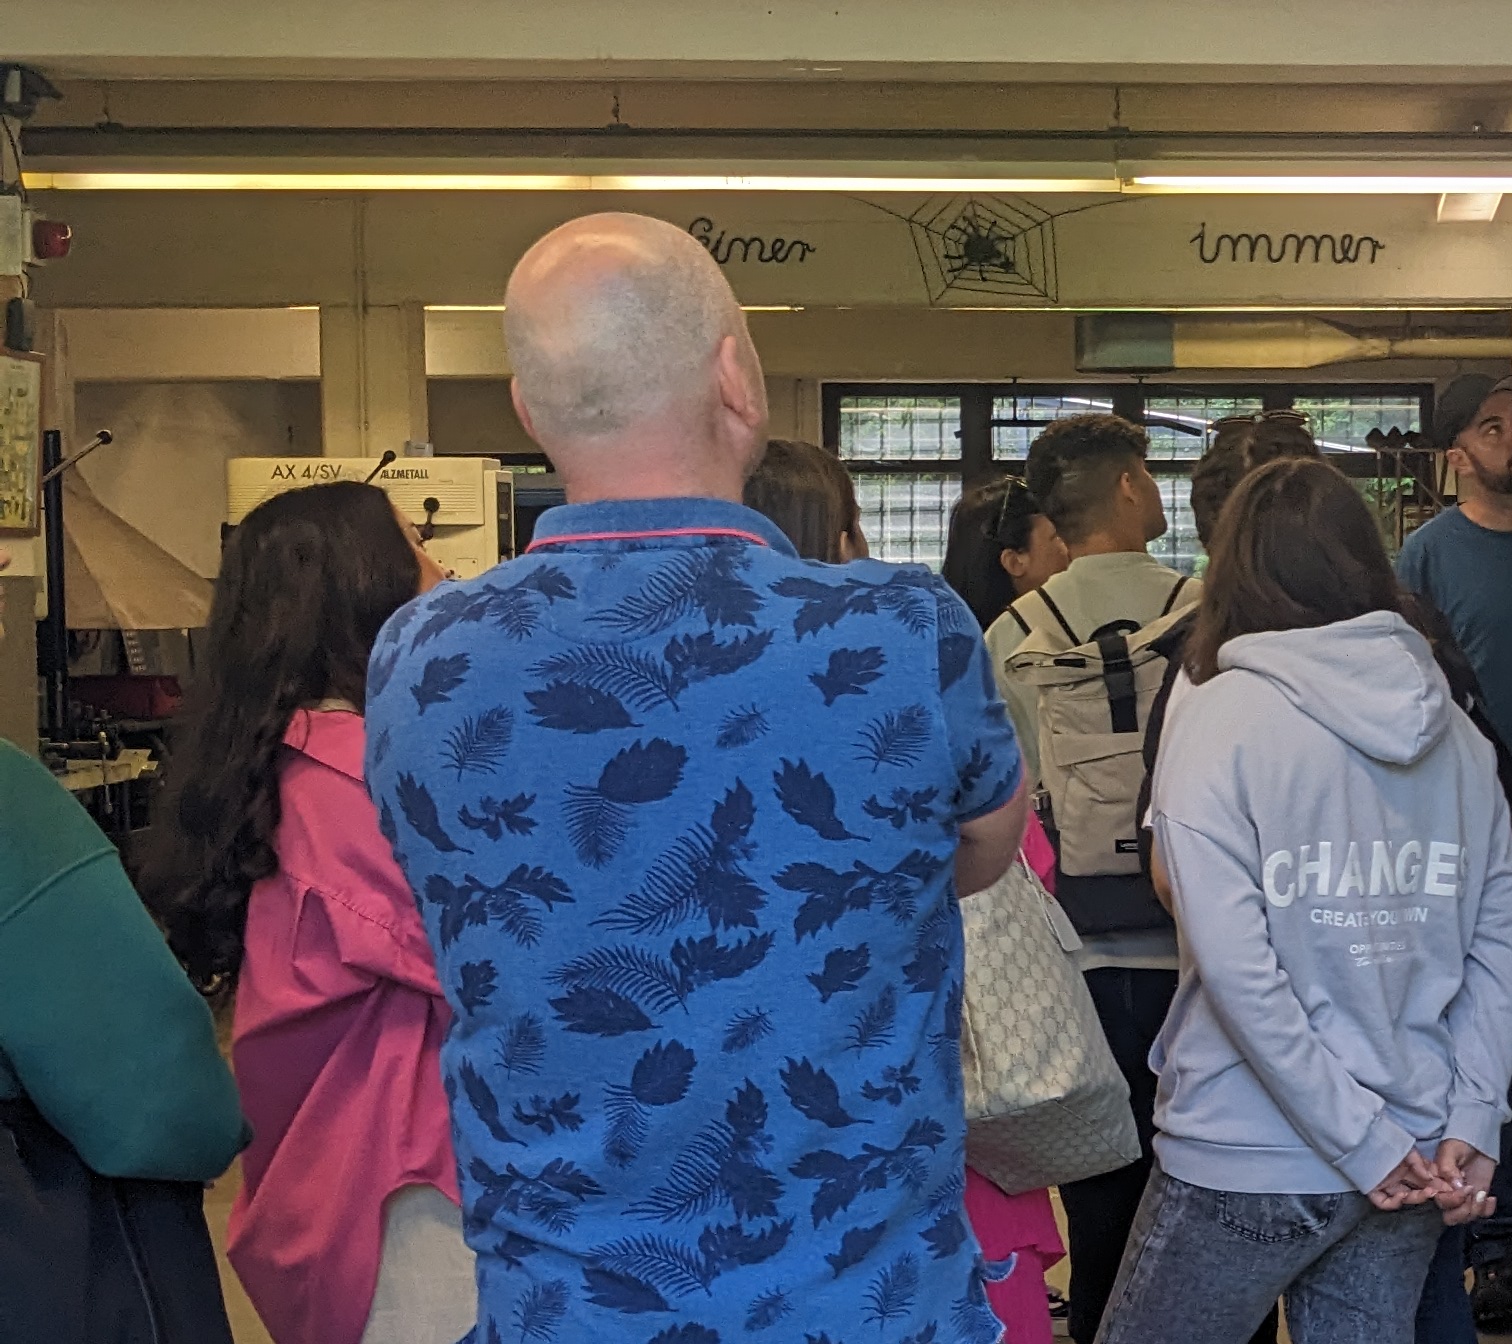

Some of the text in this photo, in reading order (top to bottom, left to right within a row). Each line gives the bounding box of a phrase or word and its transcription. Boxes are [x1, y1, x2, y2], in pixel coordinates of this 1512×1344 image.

[1190, 222, 1385, 264] immer
[271, 464, 343, 481] AX 4/SV
